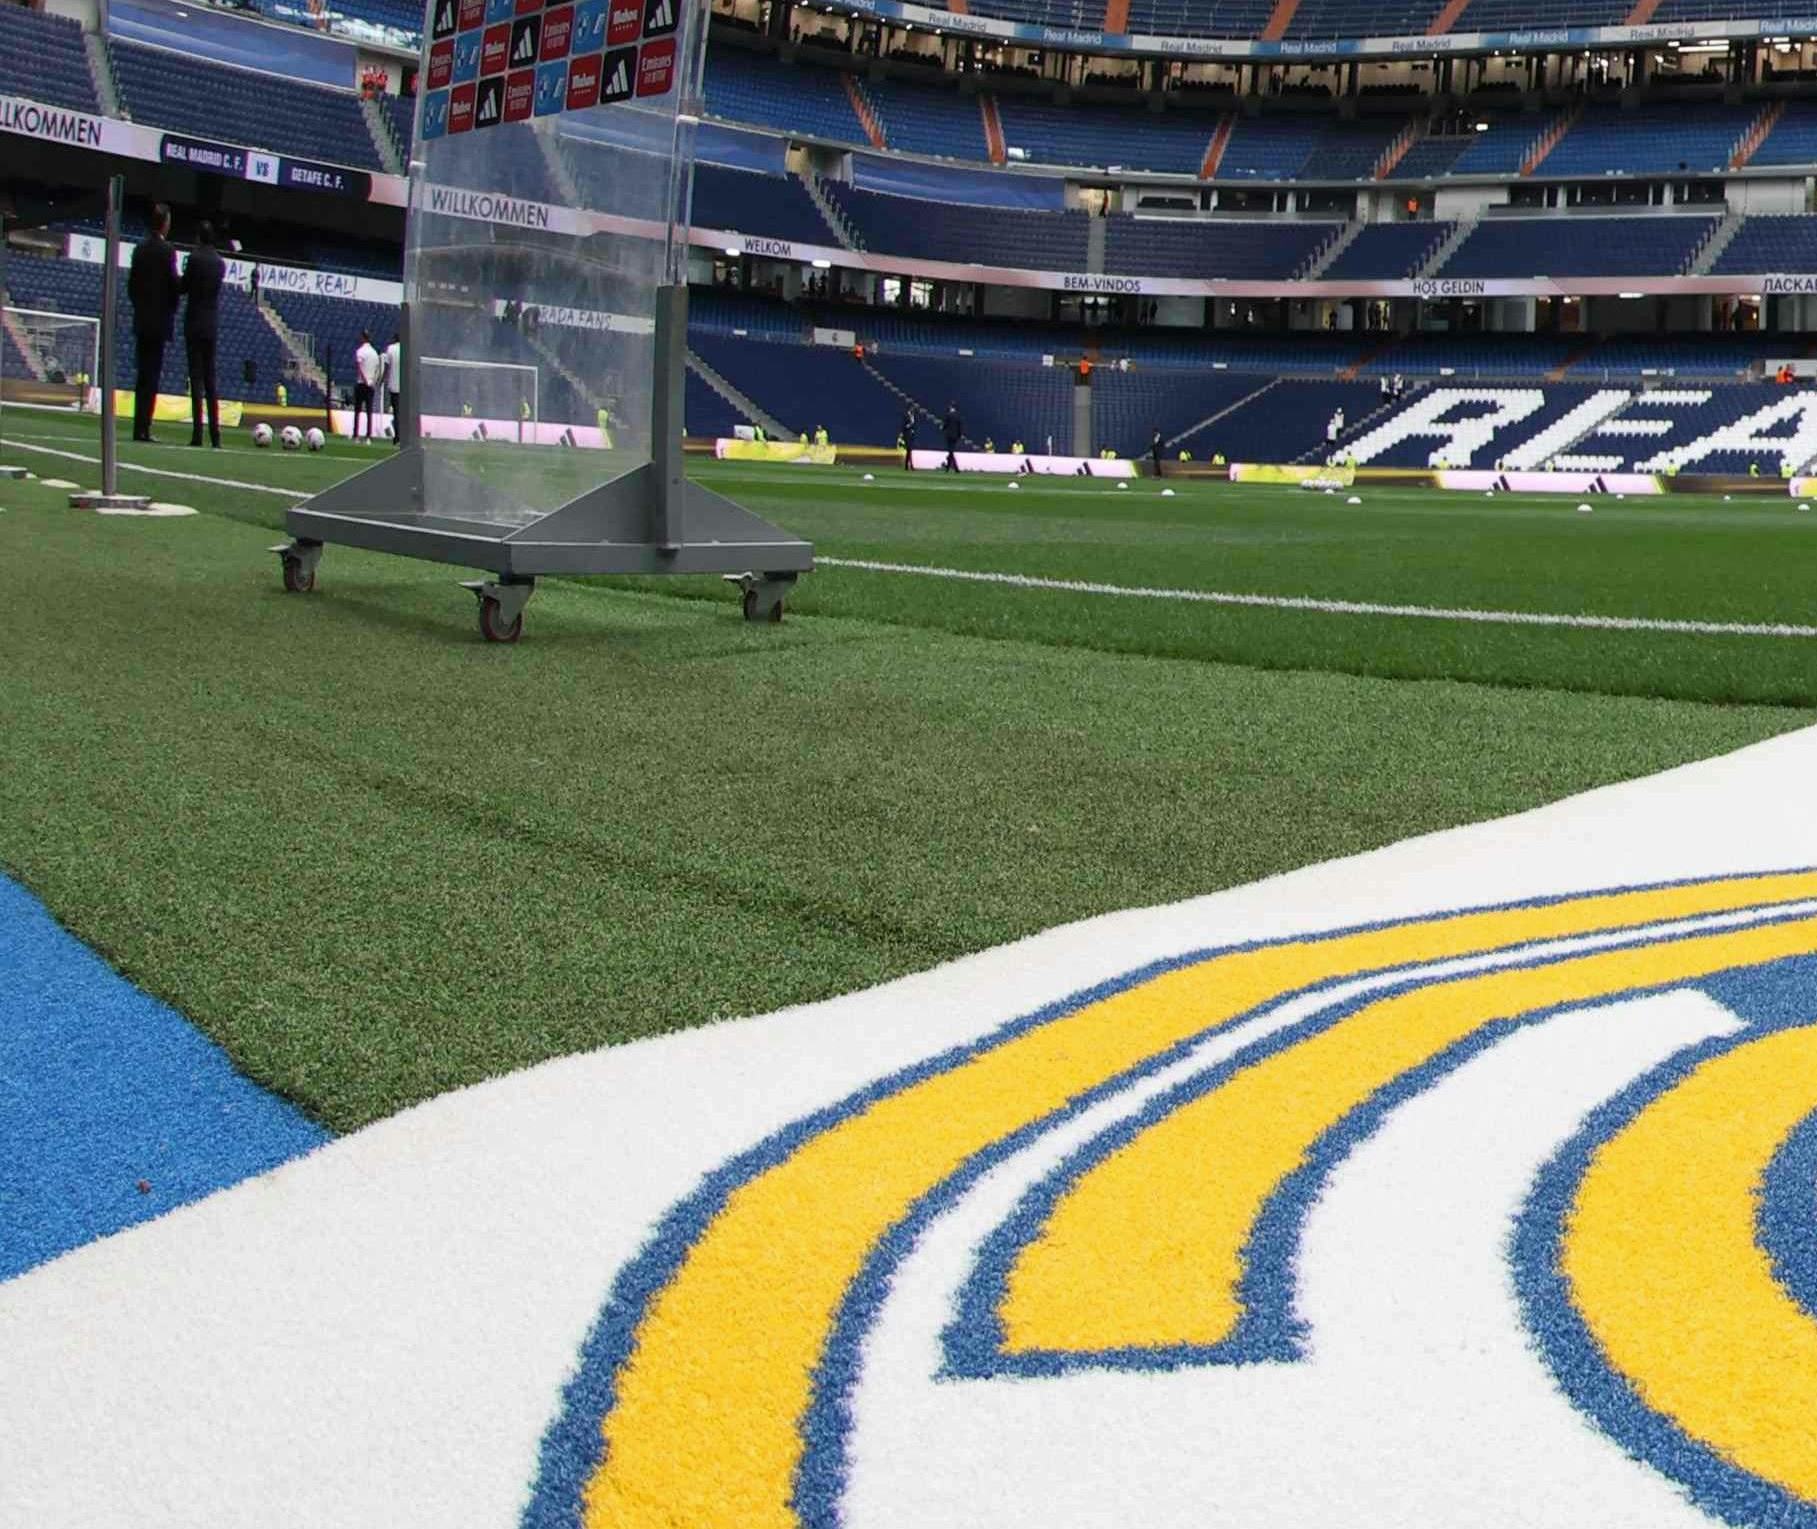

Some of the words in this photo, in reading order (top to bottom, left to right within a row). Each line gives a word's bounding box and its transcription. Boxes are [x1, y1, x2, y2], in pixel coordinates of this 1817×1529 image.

[928, 13, 950, 27] Real
[952, 16, 987, 32] Madrid
[1760, 20, 1781, 32] Real
[1043, 28, 1065, 43] Real
[1068, 31, 1103, 45] Madrid
[1508, 31, 1529, 44] Real
[1531, 29, 1569, 43] Madrid
[1630, 28, 1654, 40] Real
[1657, 26, 1695, 39] Madrid
[1161, 40, 1183, 52] Real
[1186, 40, 1223, 54] Madrid
[1280, 42, 1300, 54] Real
[1302, 40, 1337, 54] Madrid
[1392, 40, 1413, 52] Real
[1415, 37, 1452, 51] Madrid
[432, 189, 548, 227] WILLKOMMEN
[744, 238, 791, 256] WELKOM
[315, 275, 357, 297] REAL!
[1064, 276, 1142, 291] BEM-VINDOS
